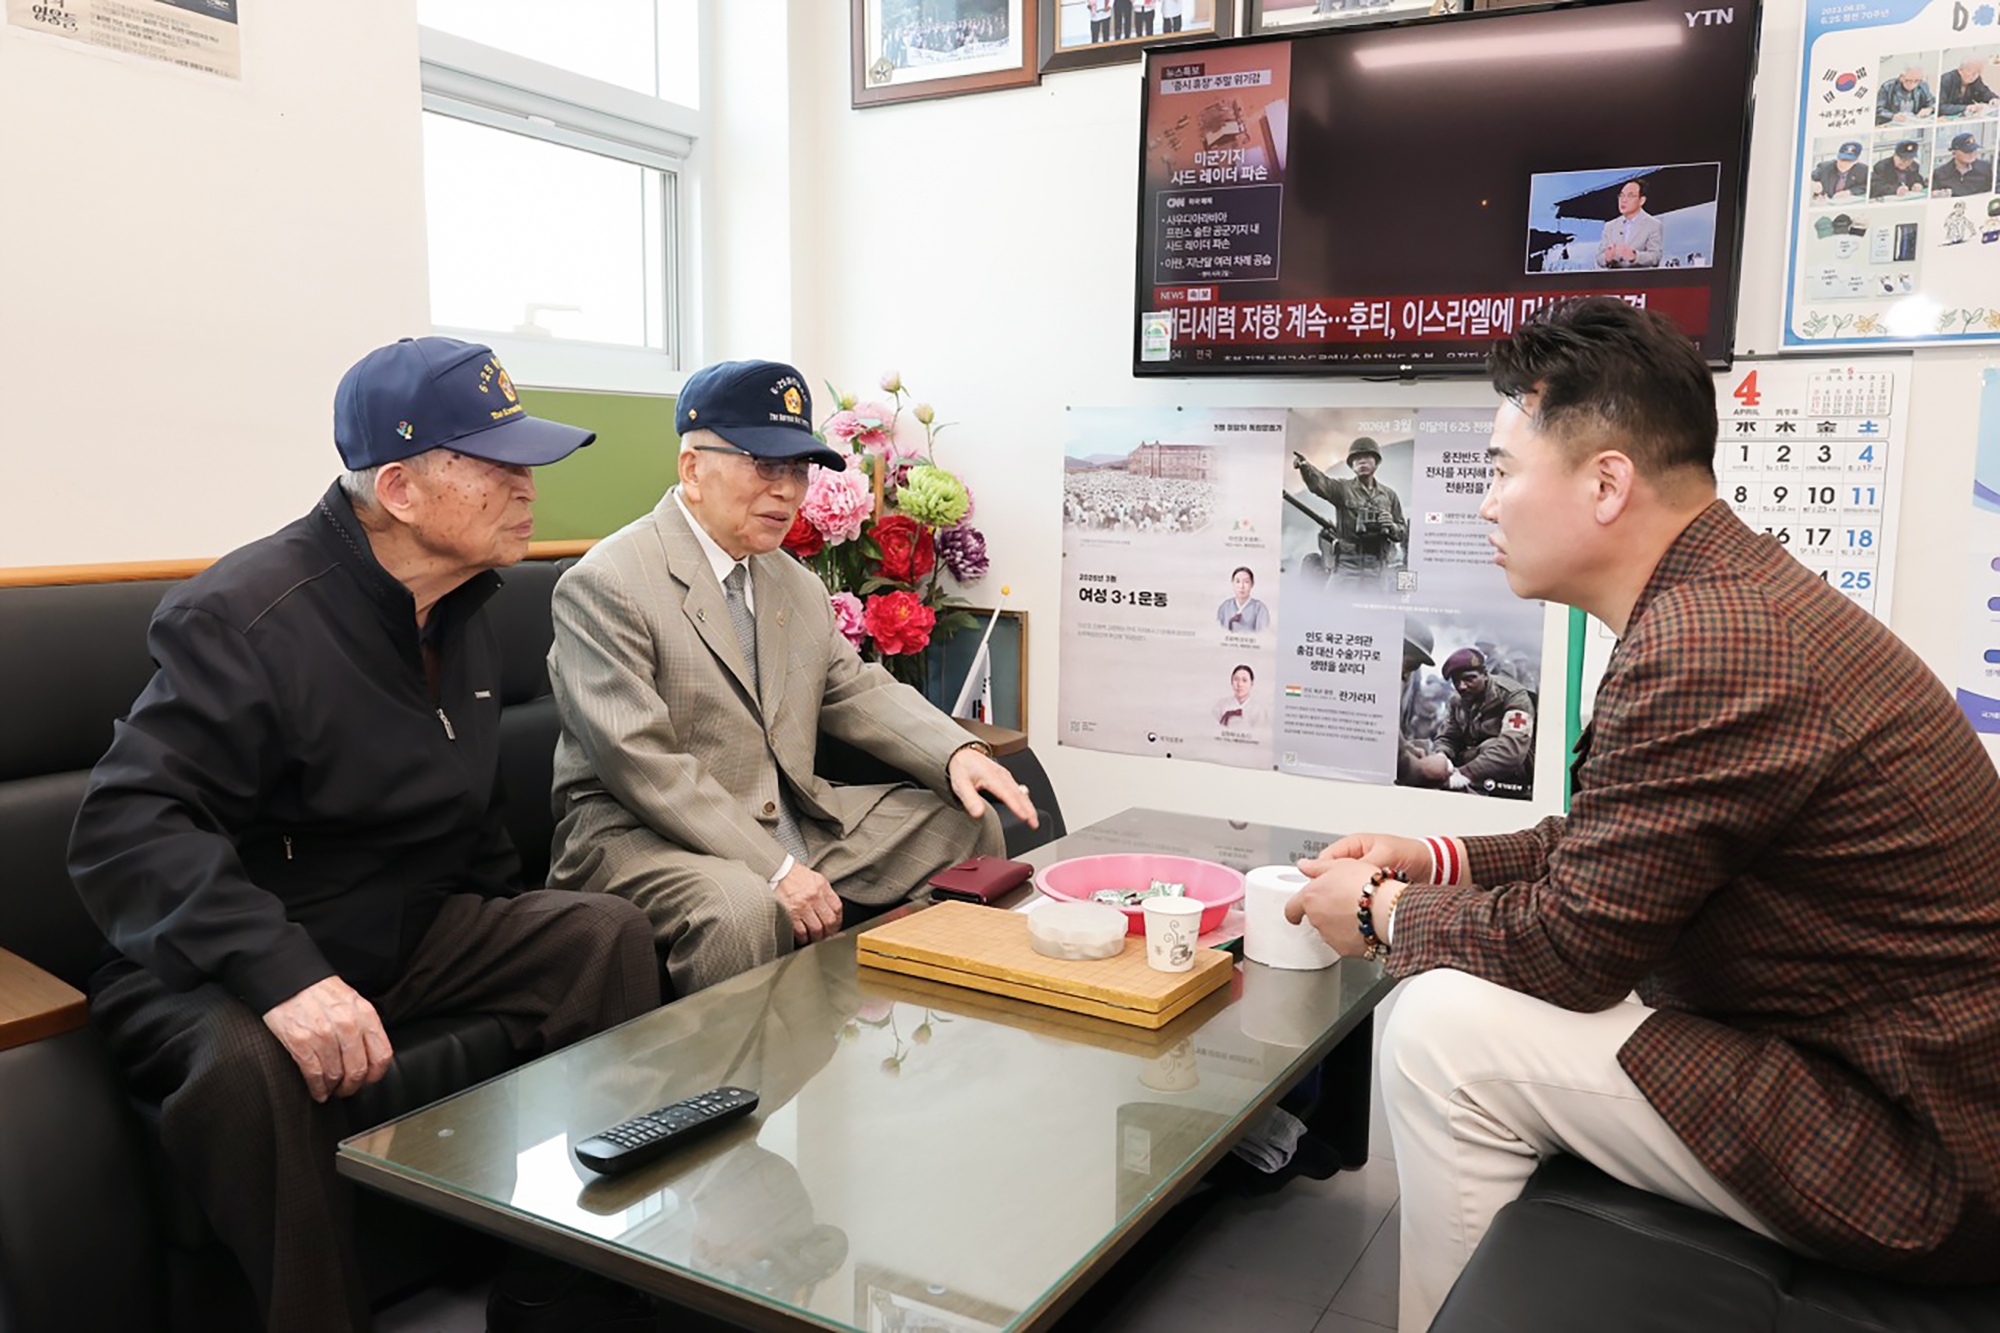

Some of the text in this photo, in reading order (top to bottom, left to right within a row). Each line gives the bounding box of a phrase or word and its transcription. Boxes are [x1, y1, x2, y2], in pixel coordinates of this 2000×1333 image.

[1684, 8, 1733, 27] YTN
[1214, 76, 1232, 87] 주말
[1194, 149, 1245, 167] 미군기지
[1171, 165, 1268, 185] 사드 레이더 파손
[1166, 198, 1185, 208] CNN
[1166, 212, 1227, 225] 사우디아라비아
[1166, 227, 1192, 239] 프린스
[1213, 224, 1248, 237] 공군기지
[1250, 223, 1260, 235] 내
[1165, 238, 1230, 251] 사드 레이더 파손
[1186, 256, 1212, 268] 지난달
[1214, 256, 1232, 267] 여러
[1253, 253, 1272, 266] 공습
[1161, 291, 1185, 300] NEWS
[1241, 303, 1282, 340] 저항
[1402, 298, 1513, 336] 이스라엘에
[1733, 370, 1761, 406] 4
[1733, 408, 1760, 416] APRIL
[1358, 421, 1390, 433] 2026년
[1393, 418, 1411, 433] 3월
[1419, 421, 1448, 433] 이달의
[1735, 421, 1757, 433] 水
[1816, 420, 1838, 434] 金
[1857, 420, 1879, 434] 土
[1740, 444, 1875, 463] 1 2 3 4
[1445, 482, 1485, 495] 전환점을
[1734, 485, 1876, 506] 8 9 10 11
[1805, 527, 1832, 546] 17
[1846, 529, 1873, 548] 18
[1840, 571, 1871, 590] 25
[1078, 587, 1169, 608] 여성 3·1운동
[1305, 632, 1373, 648] 인도 육군 군의관
[1296, 645, 1381, 662] 총검 대신 수술기구로
[1309, 660, 1366, 676] 생명을 살리다
[1339, 690, 1376, 704] 란가라지
